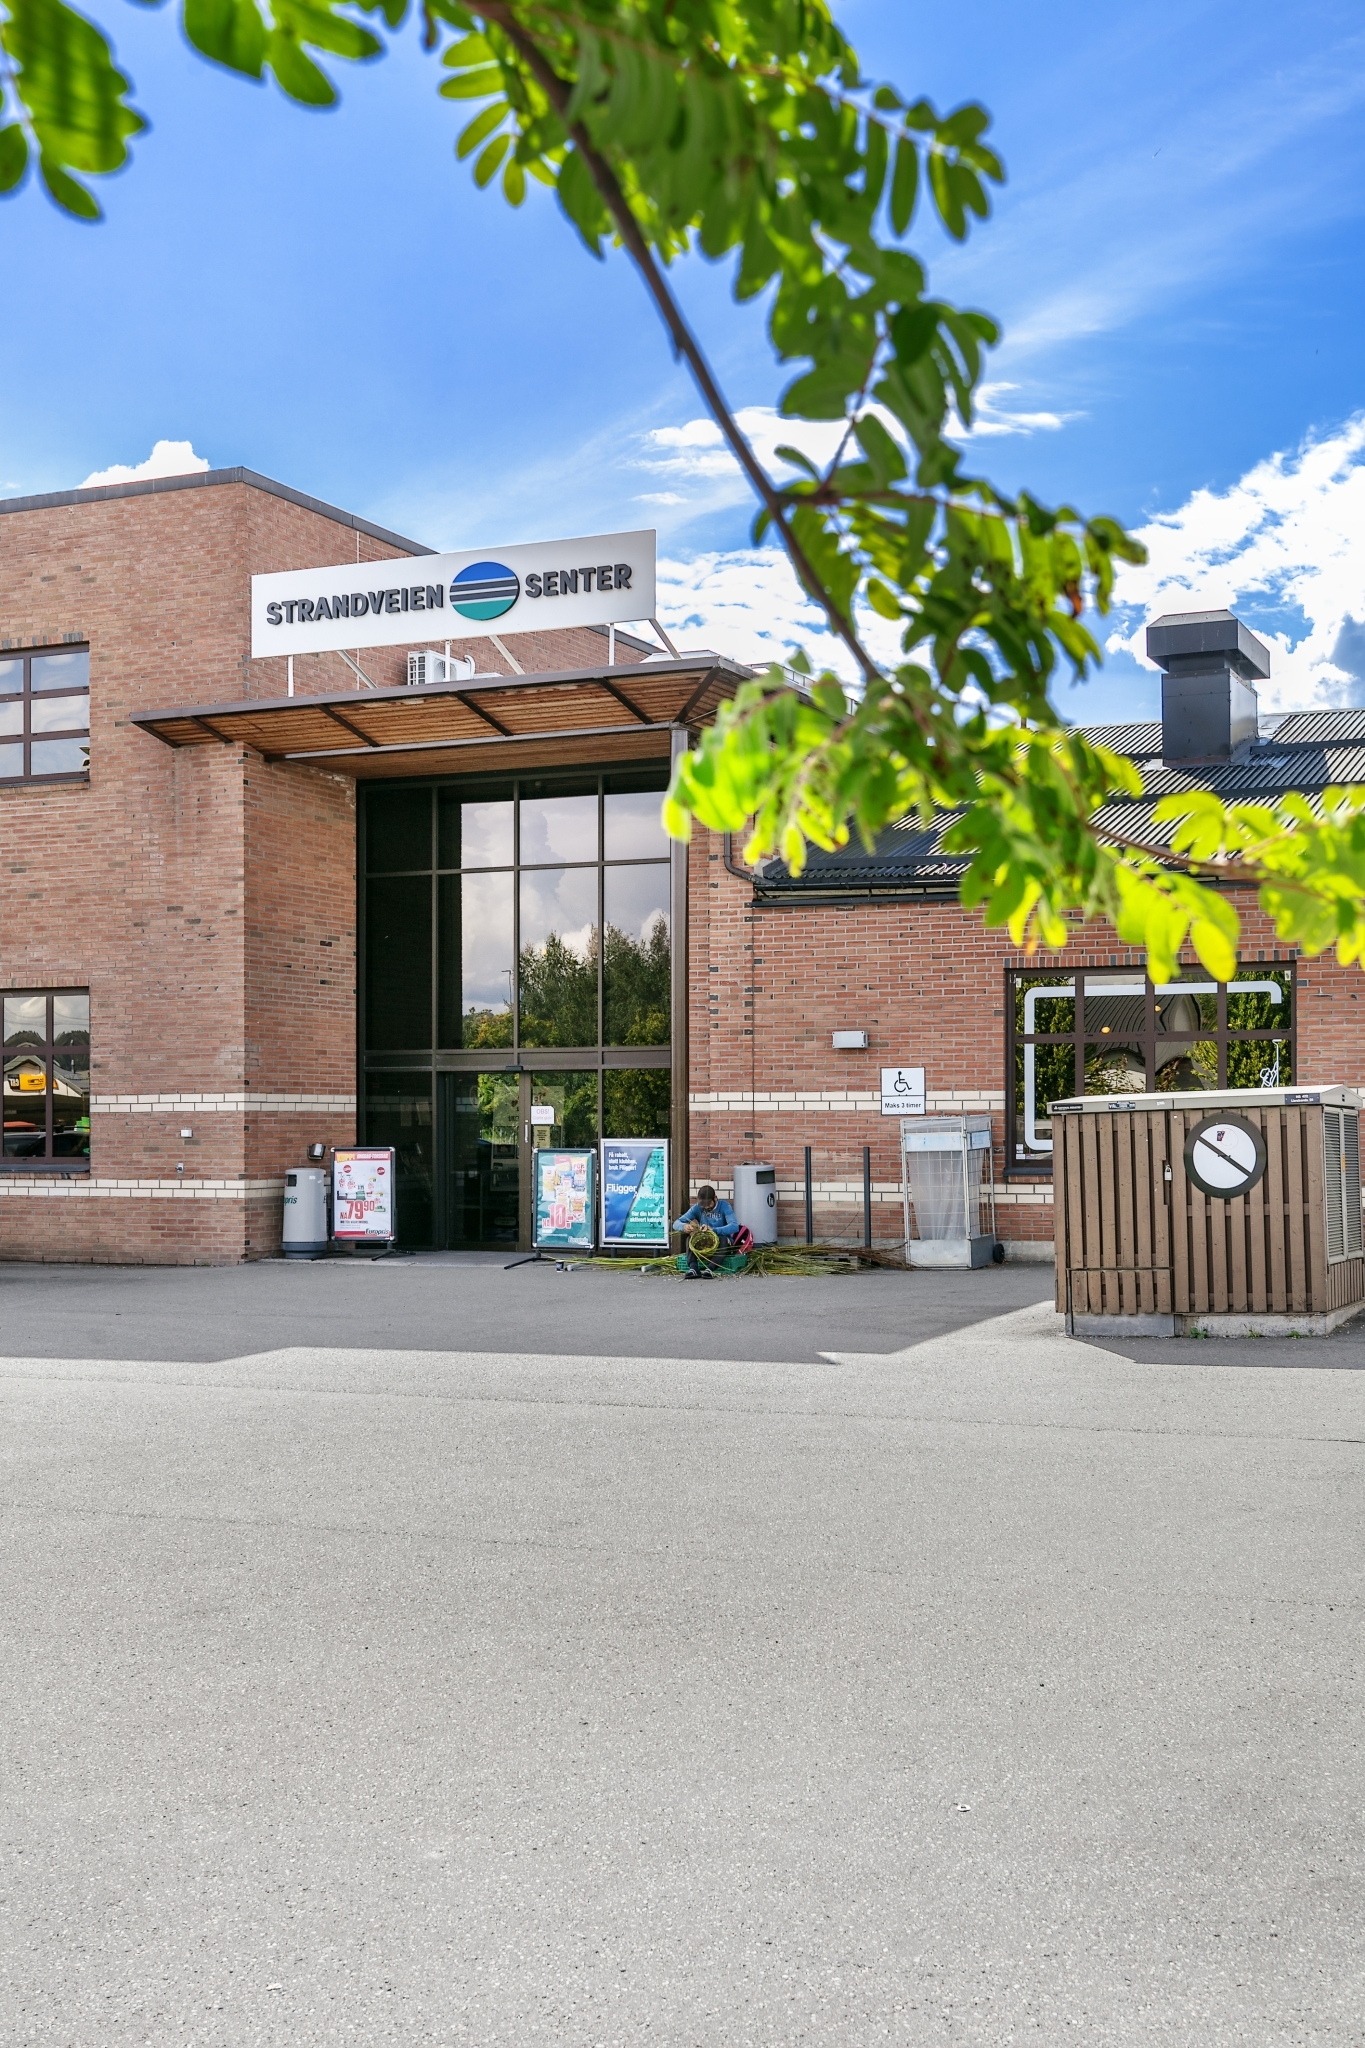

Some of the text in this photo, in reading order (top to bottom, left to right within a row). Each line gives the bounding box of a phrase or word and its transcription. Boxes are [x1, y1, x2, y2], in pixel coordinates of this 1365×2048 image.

[266, 563, 632, 626] STRANDVEIEN SENTER
[606, 1184, 637, 1194] Flügger
